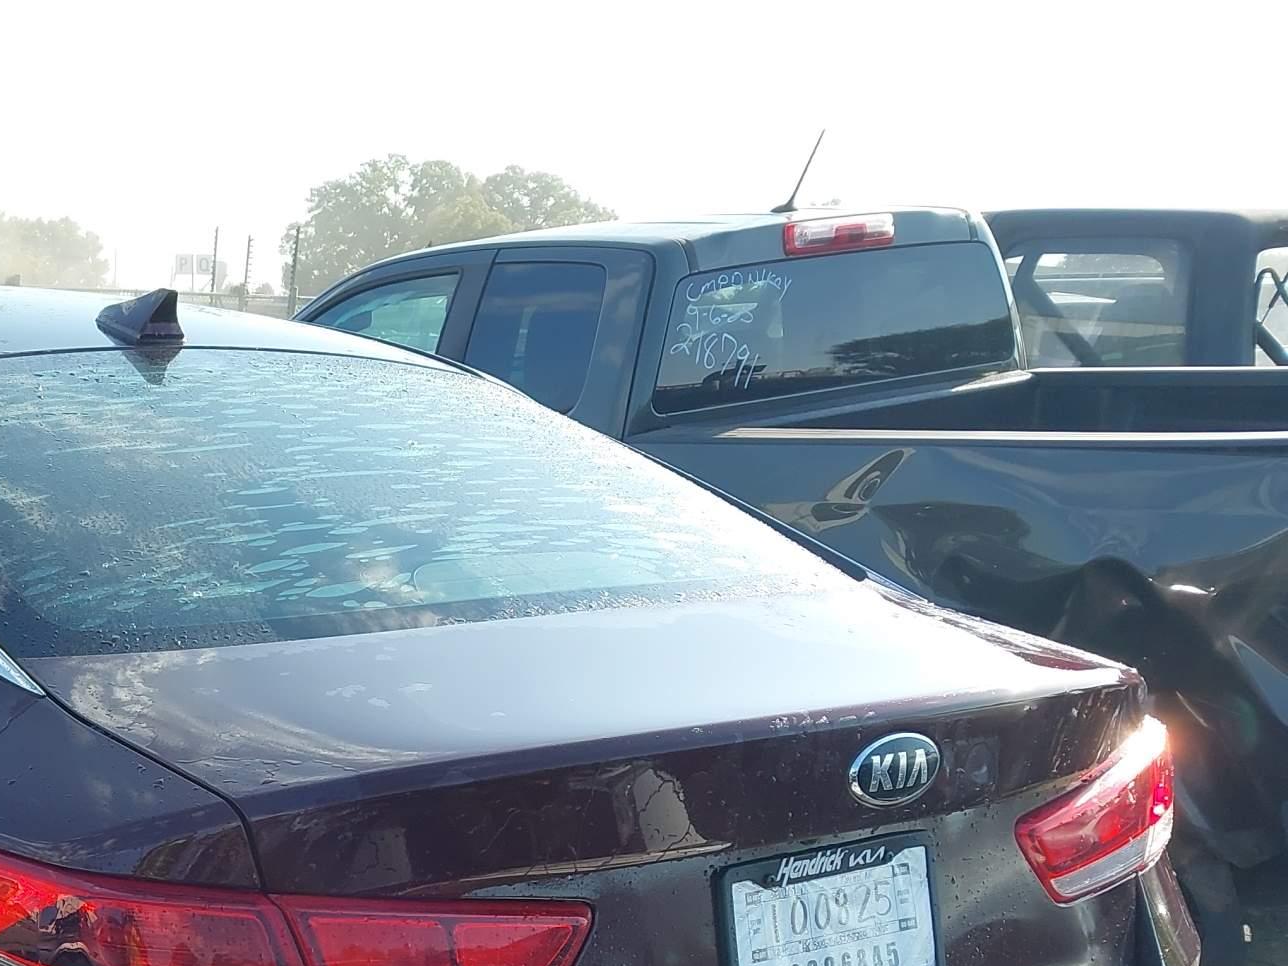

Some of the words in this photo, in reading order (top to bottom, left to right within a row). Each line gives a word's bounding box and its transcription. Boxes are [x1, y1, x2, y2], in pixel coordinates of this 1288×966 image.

[179, 256, 188, 272] P
[869, 748, 928, 793] KIA
[776, 847, 848, 888] Hendrick
